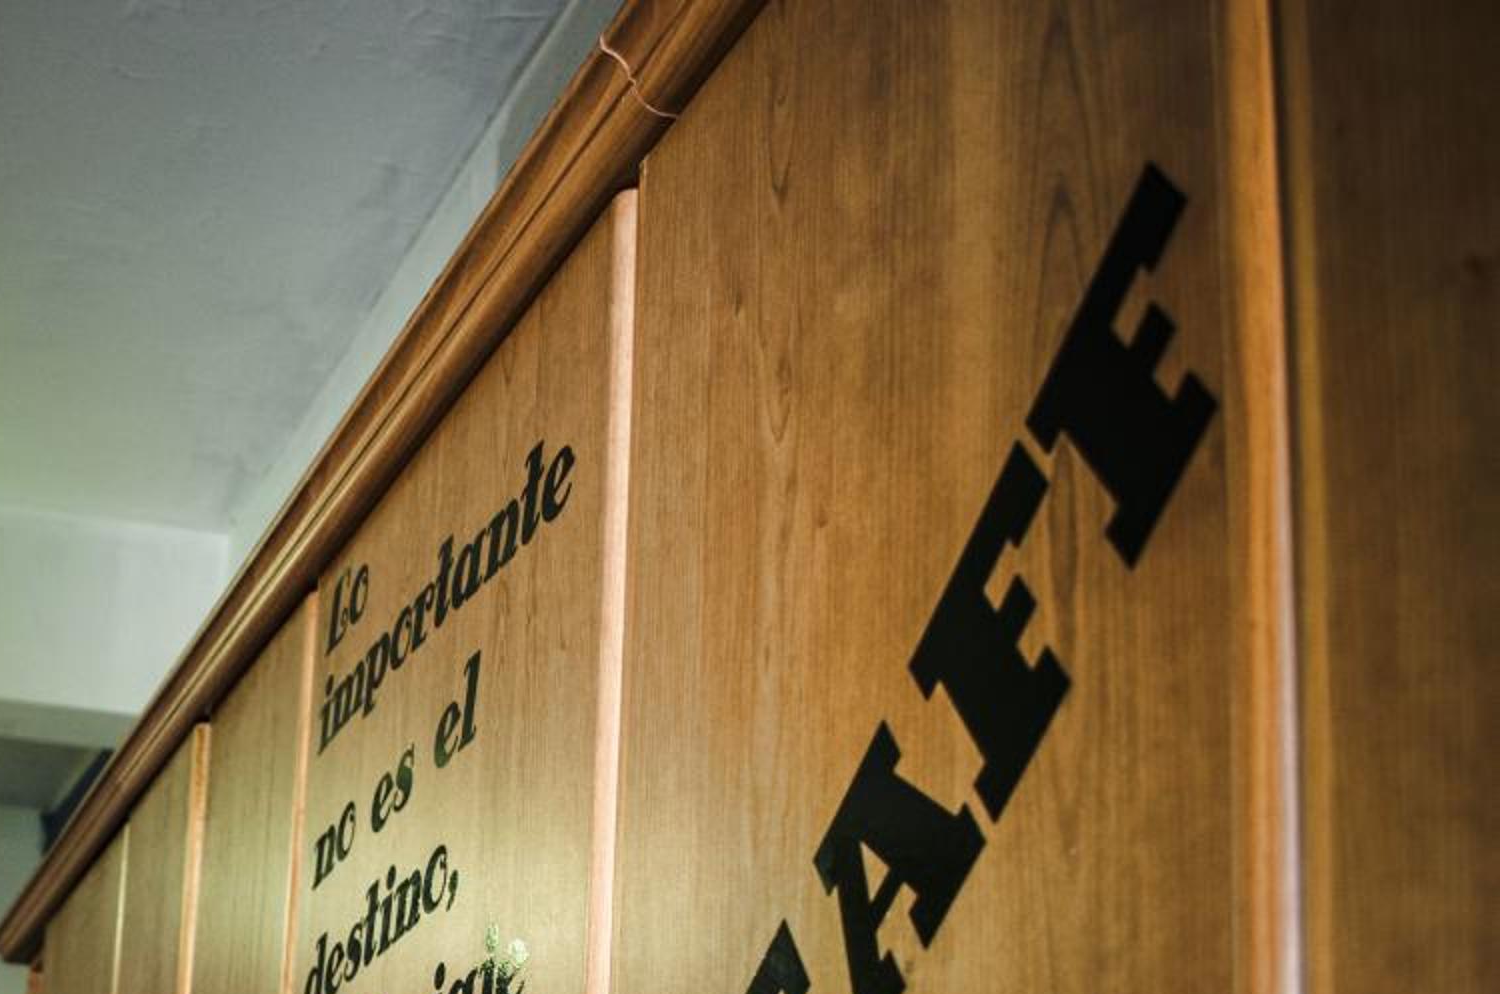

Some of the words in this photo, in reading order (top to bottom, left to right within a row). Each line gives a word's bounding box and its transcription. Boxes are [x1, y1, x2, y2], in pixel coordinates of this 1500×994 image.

[318, 440, 576, 755] importante
[326, 563, 369, 656] Lo
[313, 801, 355, 890] no
[372, 744, 415, 832] es
[434, 651, 481, 769] el
